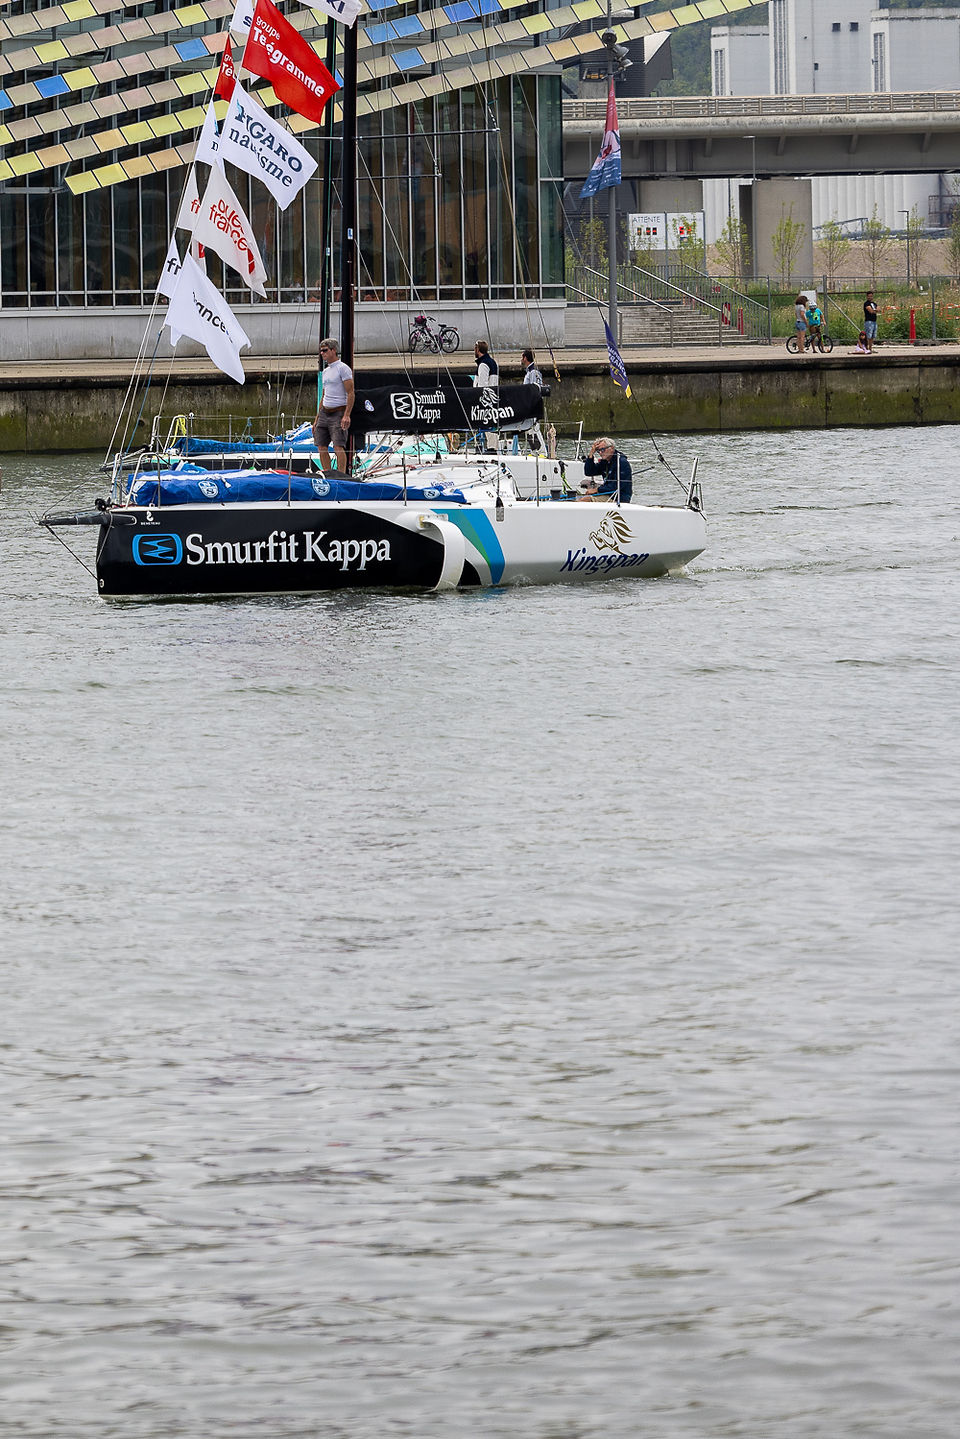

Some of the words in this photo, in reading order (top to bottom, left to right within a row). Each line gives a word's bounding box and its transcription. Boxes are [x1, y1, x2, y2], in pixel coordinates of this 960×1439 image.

[234, 99, 303, 173] FIGARO
[229, 128, 293, 187] nauisme
[415, 390, 446, 405] Smurfit
[417, 406, 442, 424] Kappa
[470, 405, 515, 425] Kingspan
[185, 530, 300, 566] Smurfit
[302, 531, 392, 571] Kappa
[559, 547, 650, 575] Kingspan
